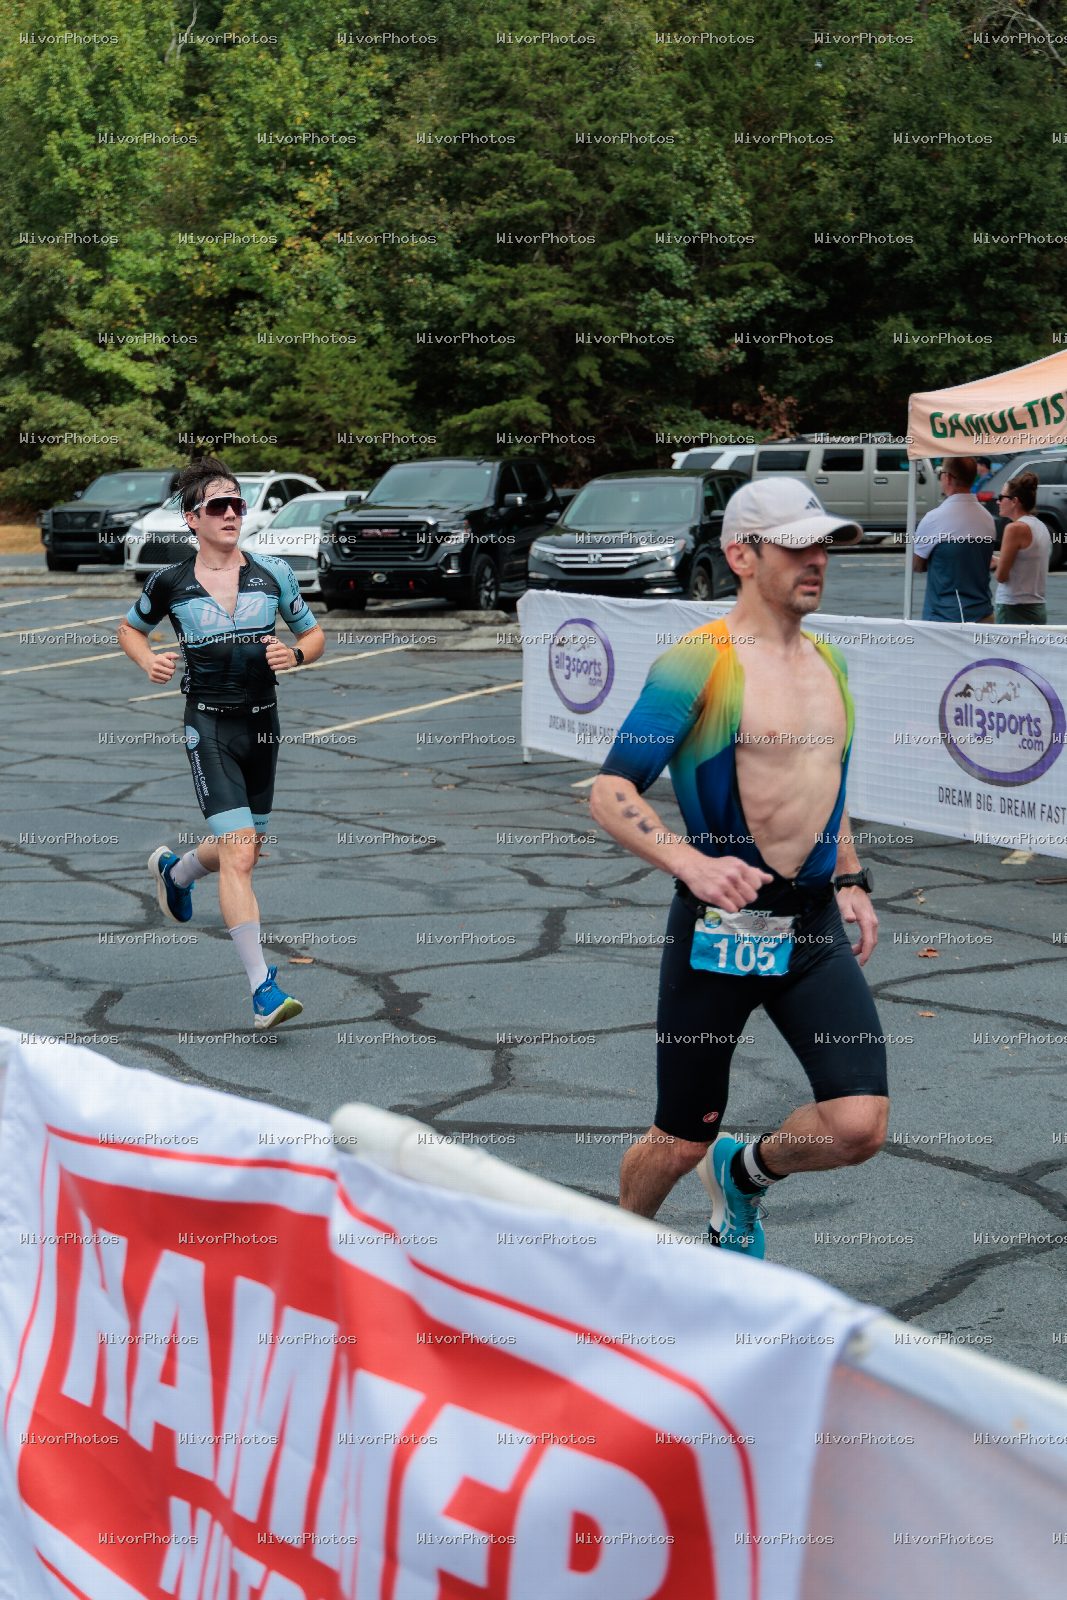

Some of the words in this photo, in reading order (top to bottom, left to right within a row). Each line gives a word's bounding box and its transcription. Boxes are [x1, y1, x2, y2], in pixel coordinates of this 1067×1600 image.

[930, 392, 1067, 439] GAMULTIS
[953, 703, 1043, 739] all3sports
[1018, 737, 1044, 752] .com
[938, 786, 972, 808] DREAM
[976, 793, 996, 813] BIG.
[1000, 797, 1036, 820] DREAM
[1040, 804, 1067, 825] FAST
[713, 938, 775, 972] 105
